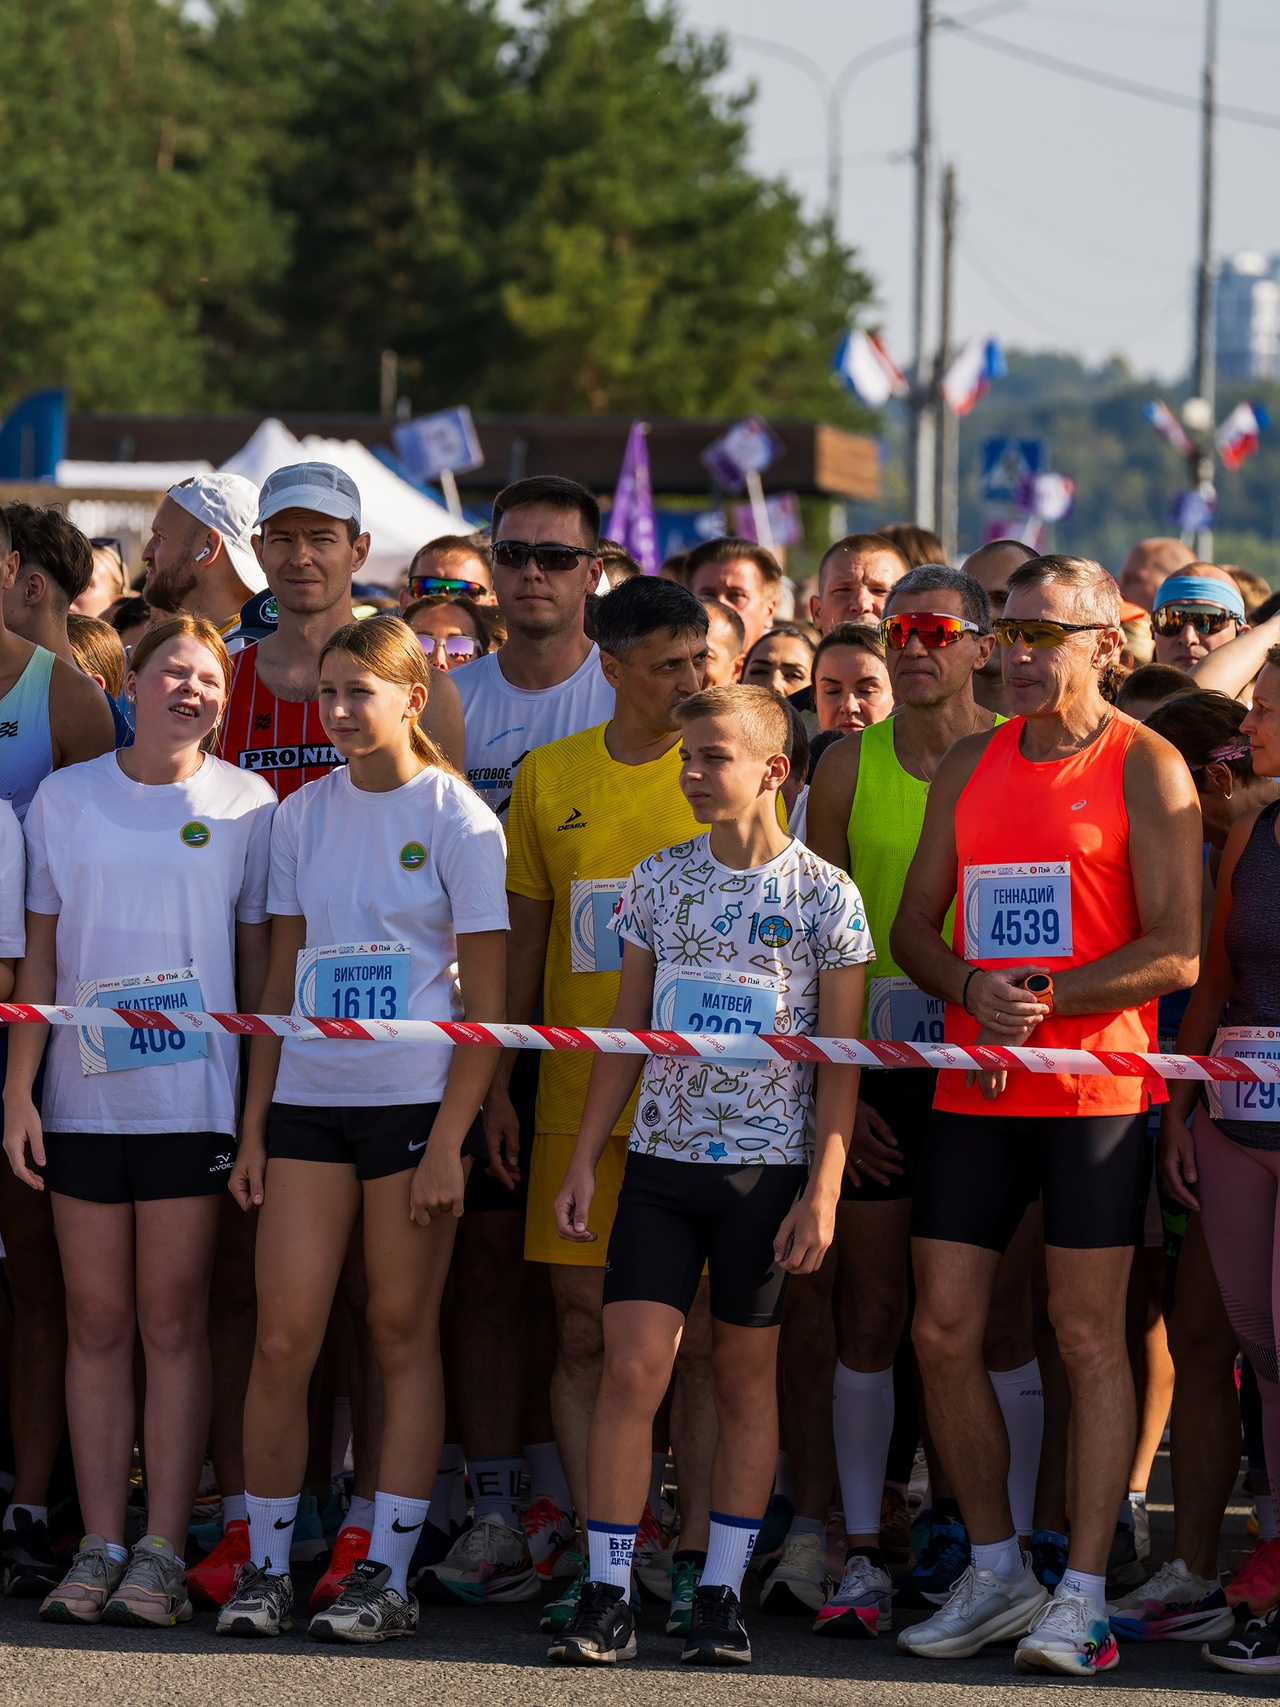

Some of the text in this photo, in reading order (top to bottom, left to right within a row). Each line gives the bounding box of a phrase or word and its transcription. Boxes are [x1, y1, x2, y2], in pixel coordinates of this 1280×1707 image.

[467, 767, 512, 781] БЕГОВОЕ
[556, 822, 588, 832] DEMIX
[1038, 866, 1050, 874] Пэй
[994, 884, 1054, 905] ГЕННАДИЙ
[990, 908, 1060, 946] 4539
[378, 944, 391, 952] Пэй
[166, 972, 178, 980] Пэй
[334, 964, 392, 983] ВИКТОРИЯ
[747, 978, 760, 986] Пэй
[332, 986, 396, 1020] 1613
[702, 992, 752, 1014] МАТВЕЙ
[1267, 1062, 1280, 1074] ПОРТ
[1236, 1080, 1280, 1110] 129
